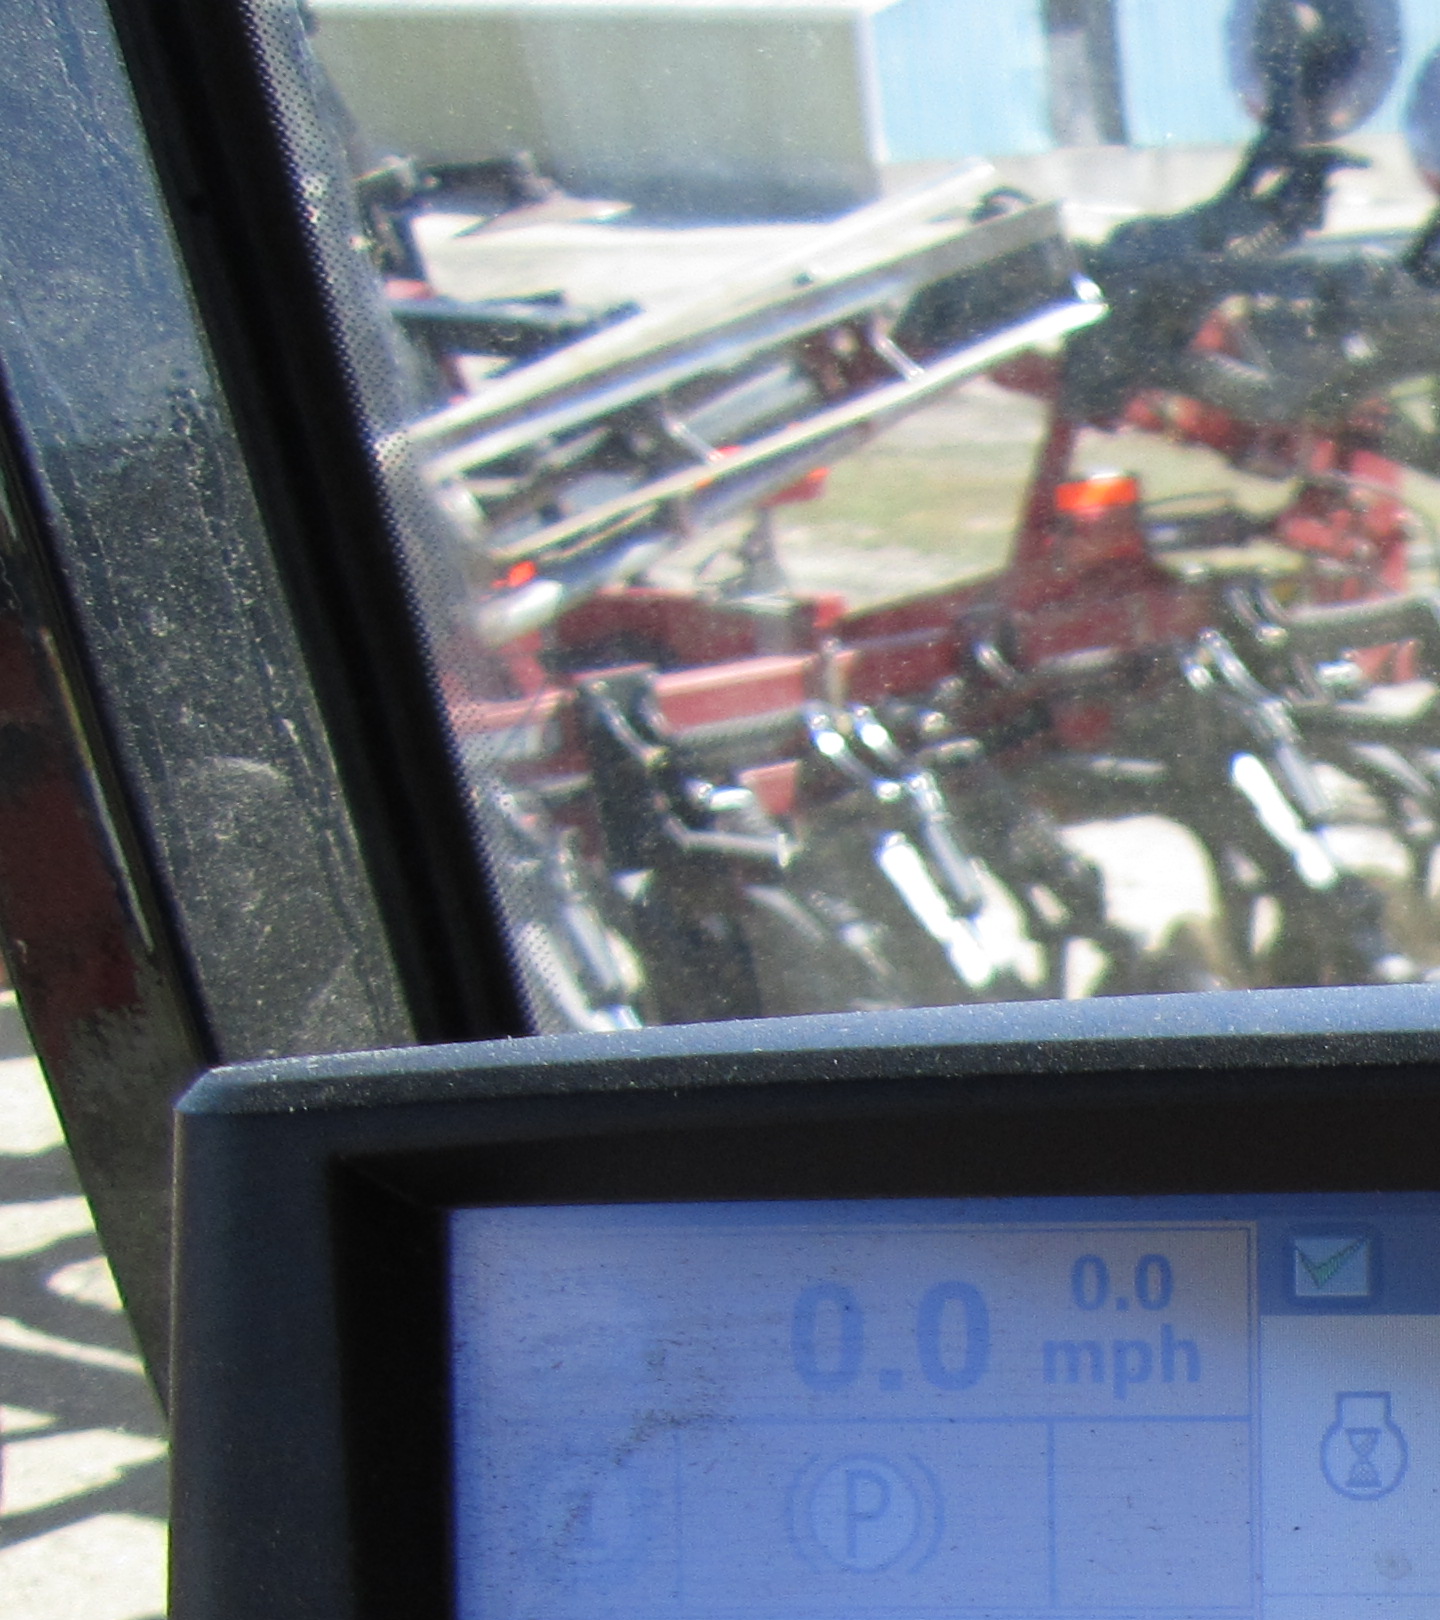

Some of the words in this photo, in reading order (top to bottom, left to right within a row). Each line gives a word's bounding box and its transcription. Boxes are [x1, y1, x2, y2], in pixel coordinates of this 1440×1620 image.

[1070, 1254, 1174, 1311] 0.0
[791, 1281, 991, 1392] 0.0
[1043, 1326, 1201, 1399] mph
